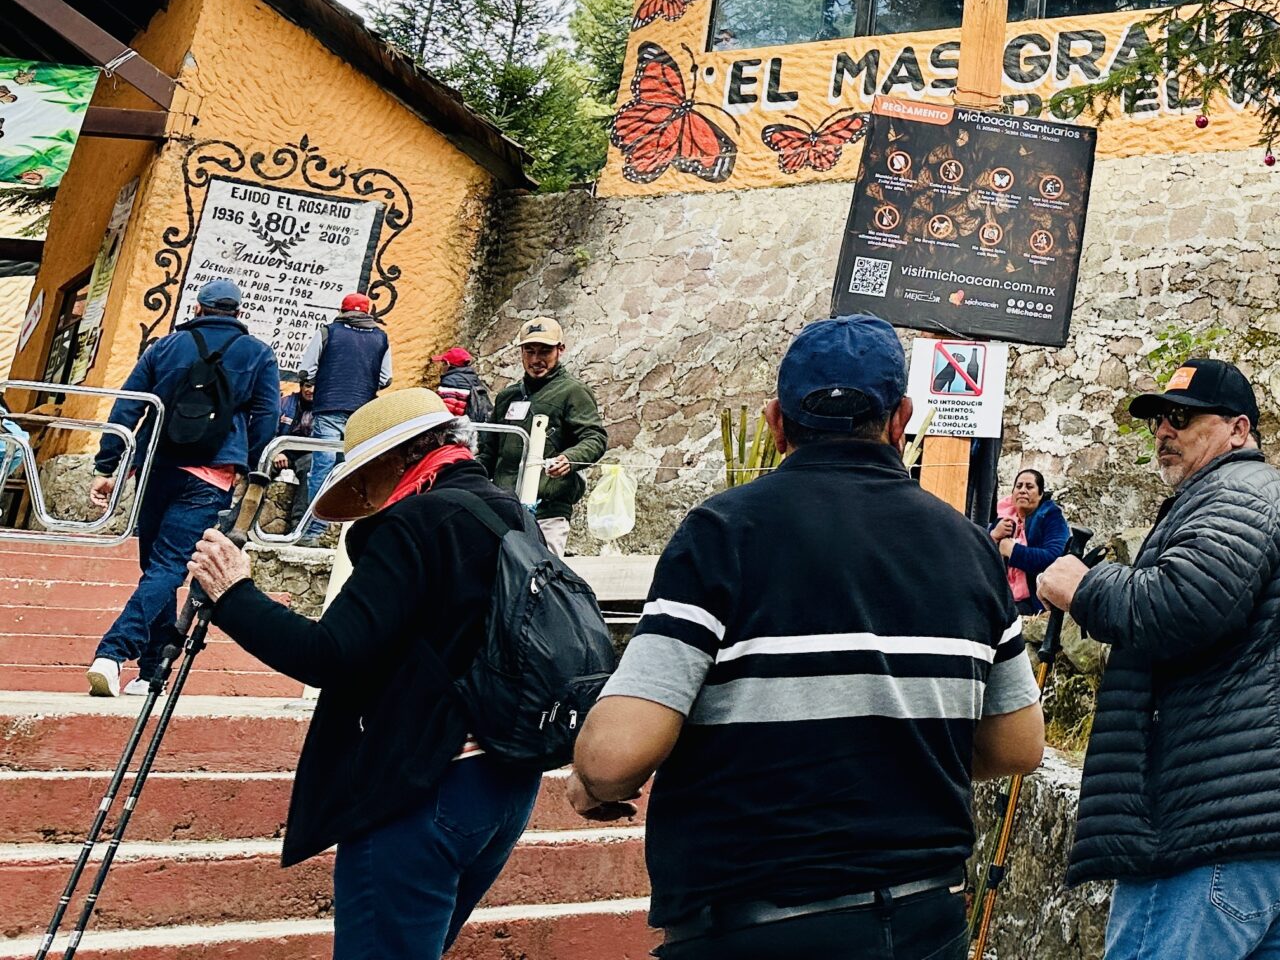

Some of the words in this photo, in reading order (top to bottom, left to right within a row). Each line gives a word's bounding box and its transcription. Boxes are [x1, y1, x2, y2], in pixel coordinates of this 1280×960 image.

[728, 57, 798, 104] EL
[832, 41, 961, 97] MAS
[881, 101, 949, 120] REGLAMENTO
[957, 111, 1020, 129] Michoacán
[1022, 121, 1080, 139] Santuarios
[231, 186, 271, 206] EJIDO
[276, 195, 293, 212] EL
[298, 200, 352, 219] ROSARIO
[212, 206, 245, 225] 1936
[264, 212, 296, 236] 80
[319, 231, 351, 246] 2010
[238, 279, 248, 288] AL
[251, 281, 272, 293] PUB.
[290, 287, 314, 300] 1982
[901, 264, 1056, 297] visitmichoacan.com.mx
[253, 293, 298, 308] BIOSFERA
[273, 307, 328, 323] MONARCA
